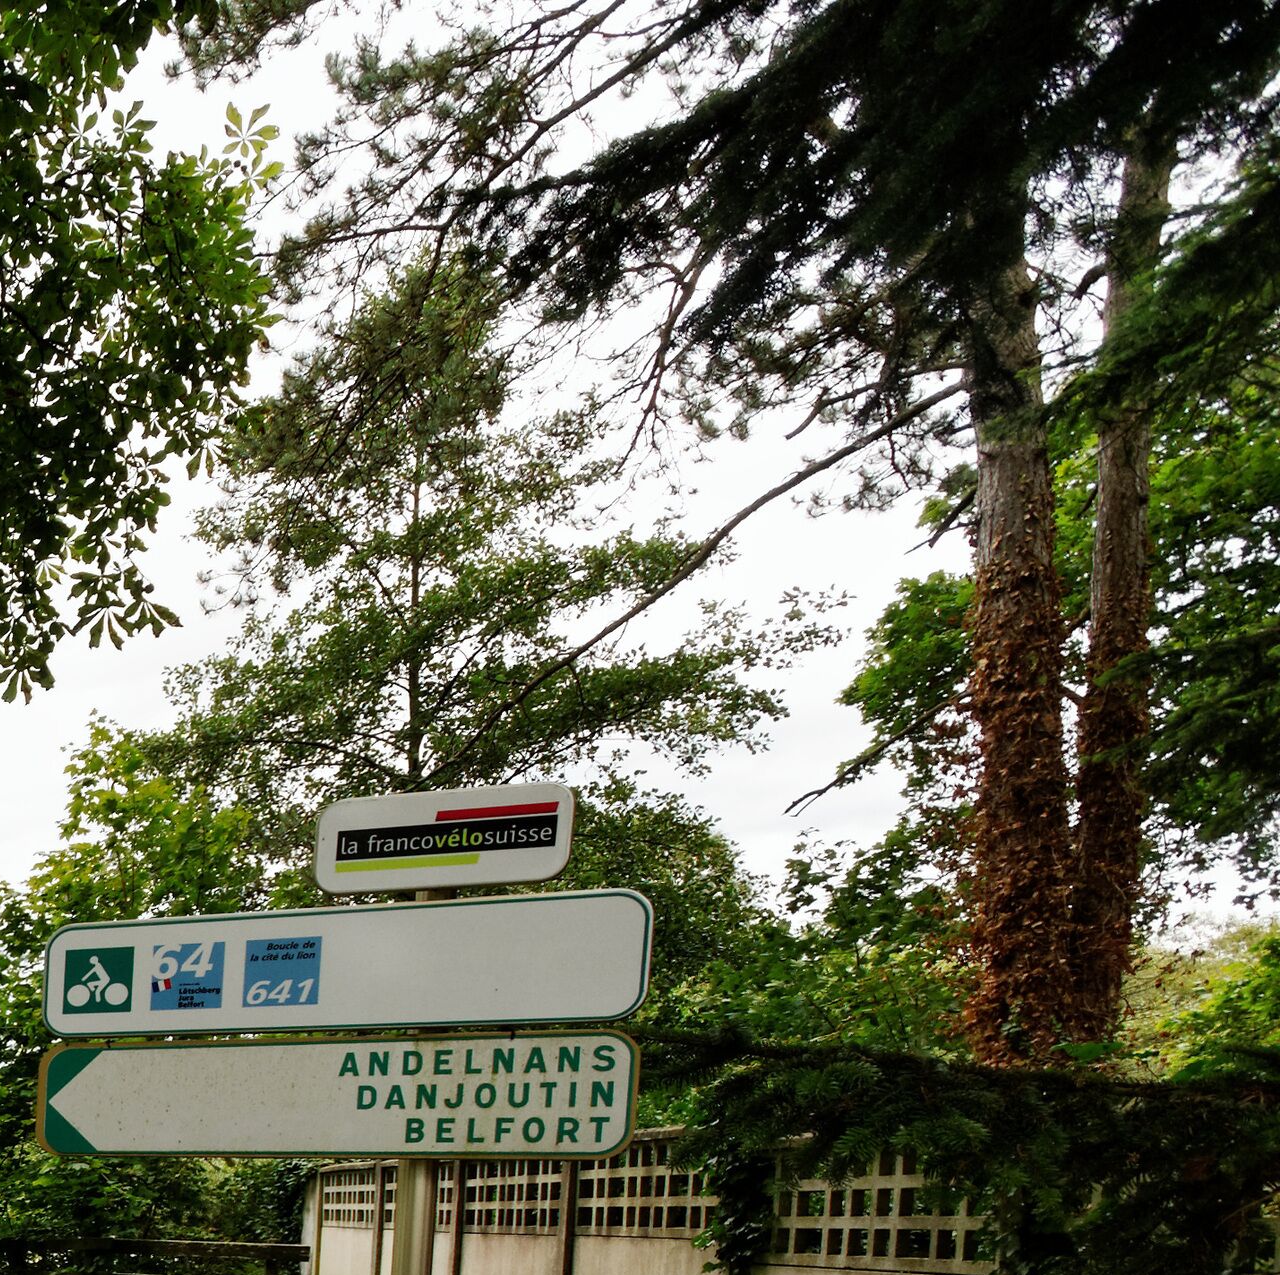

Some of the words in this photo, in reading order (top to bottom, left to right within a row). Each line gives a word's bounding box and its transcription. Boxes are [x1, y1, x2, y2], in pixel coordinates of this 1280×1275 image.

[340, 837, 358, 855] la
[367, 823, 553, 853] francovélosuisse
[250, 953, 259, 962] la
[261, 952, 279, 961] cité
[281, 951, 295, 961] du
[297, 950, 316, 960] lion
[266, 941, 300, 951] Boucle
[302, 940, 316, 949] de
[151, 941, 216, 980] 64
[245, 978, 315, 1005] 641
[338, 1044, 616, 1078] ANDELNANS
[356, 1080, 615, 1110] DANJOUTIN
[404, 1116, 611, 1144] BELFORT
